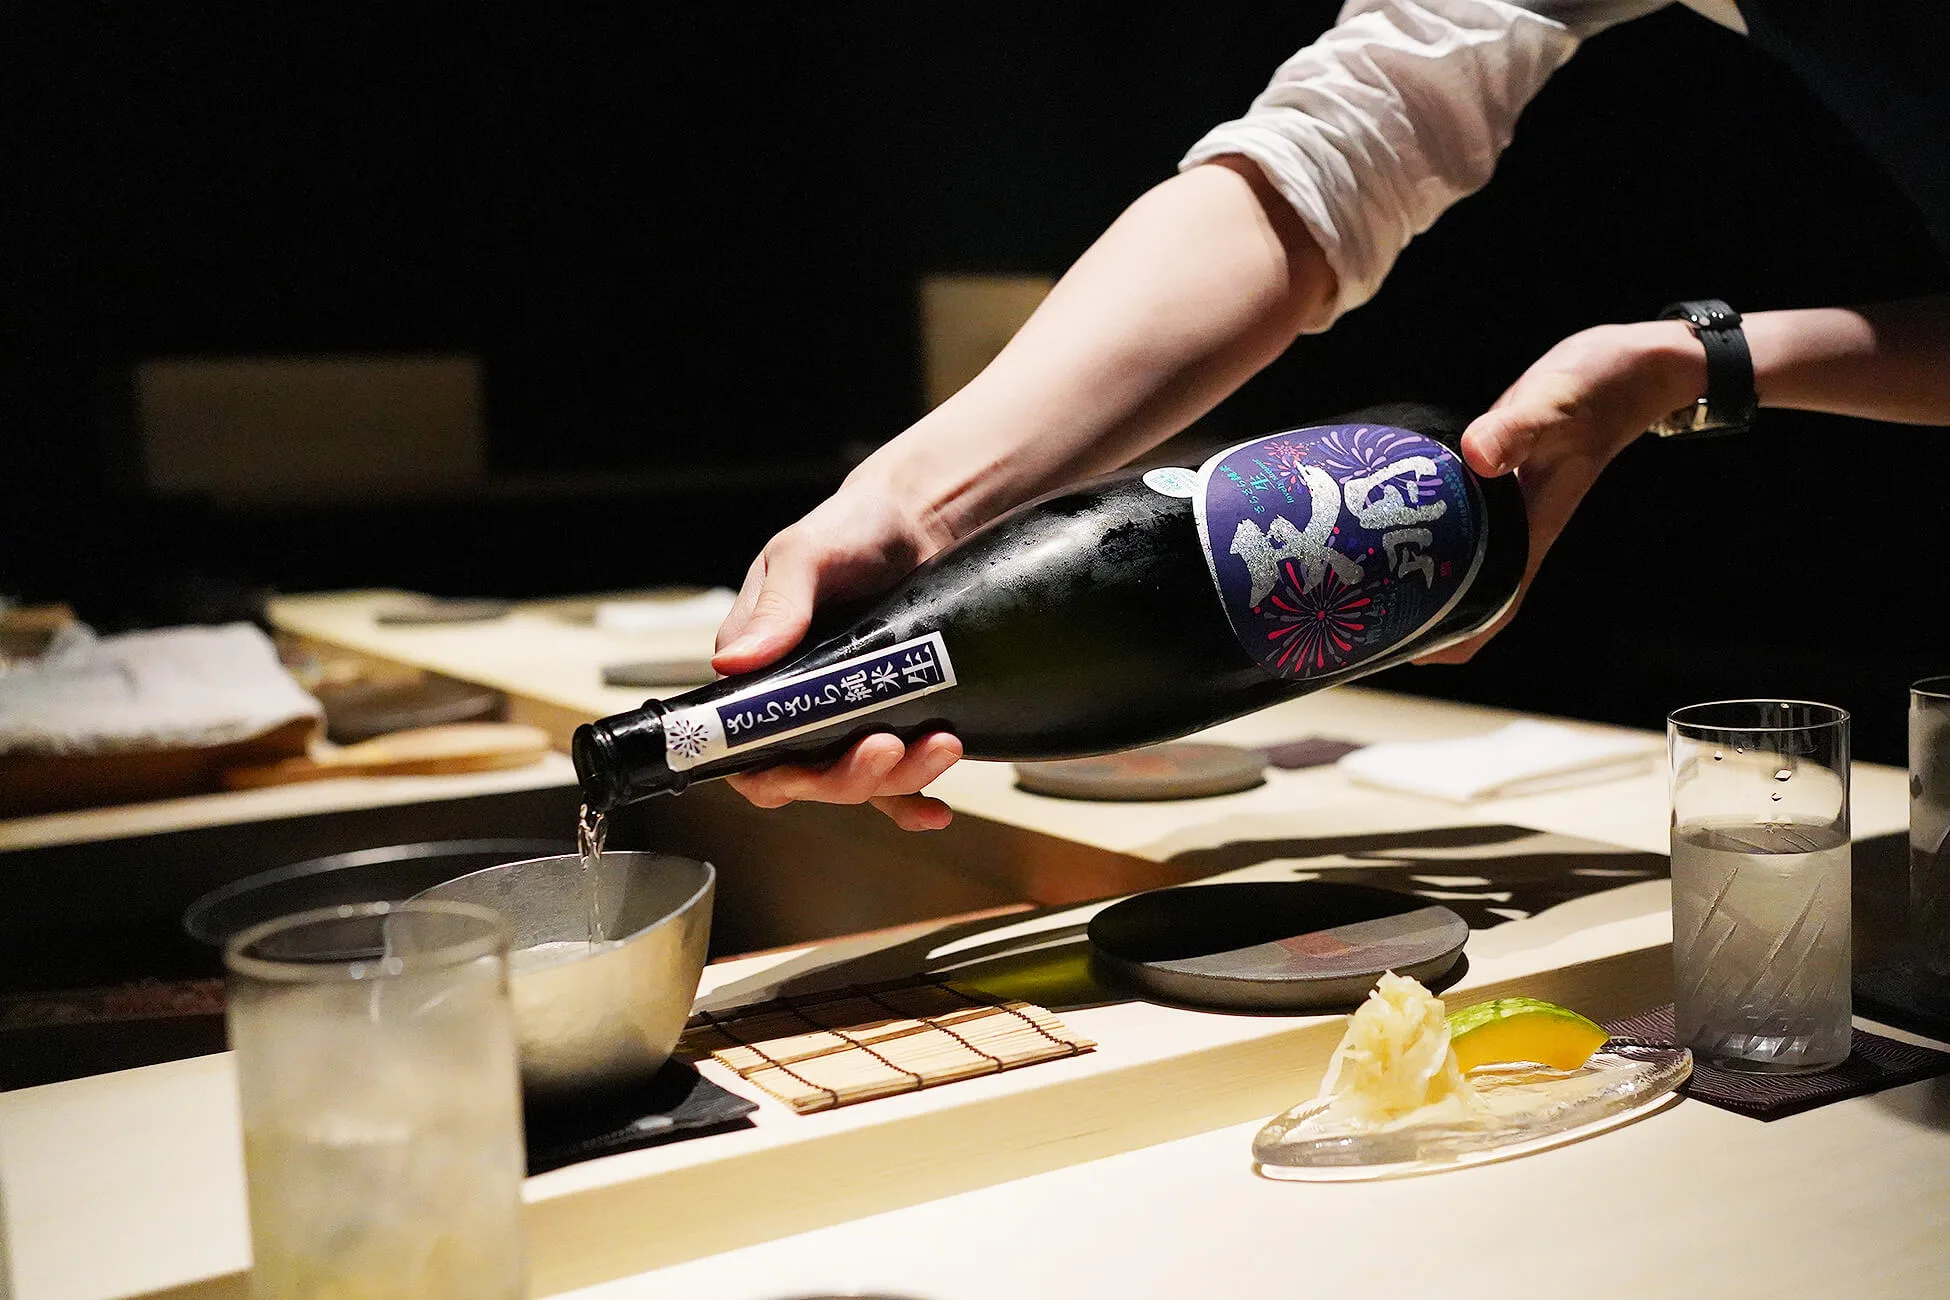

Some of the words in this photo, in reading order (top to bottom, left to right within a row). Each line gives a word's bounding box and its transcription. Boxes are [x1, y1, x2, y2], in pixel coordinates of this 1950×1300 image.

[726, 644, 941, 735] さらさら純米生
